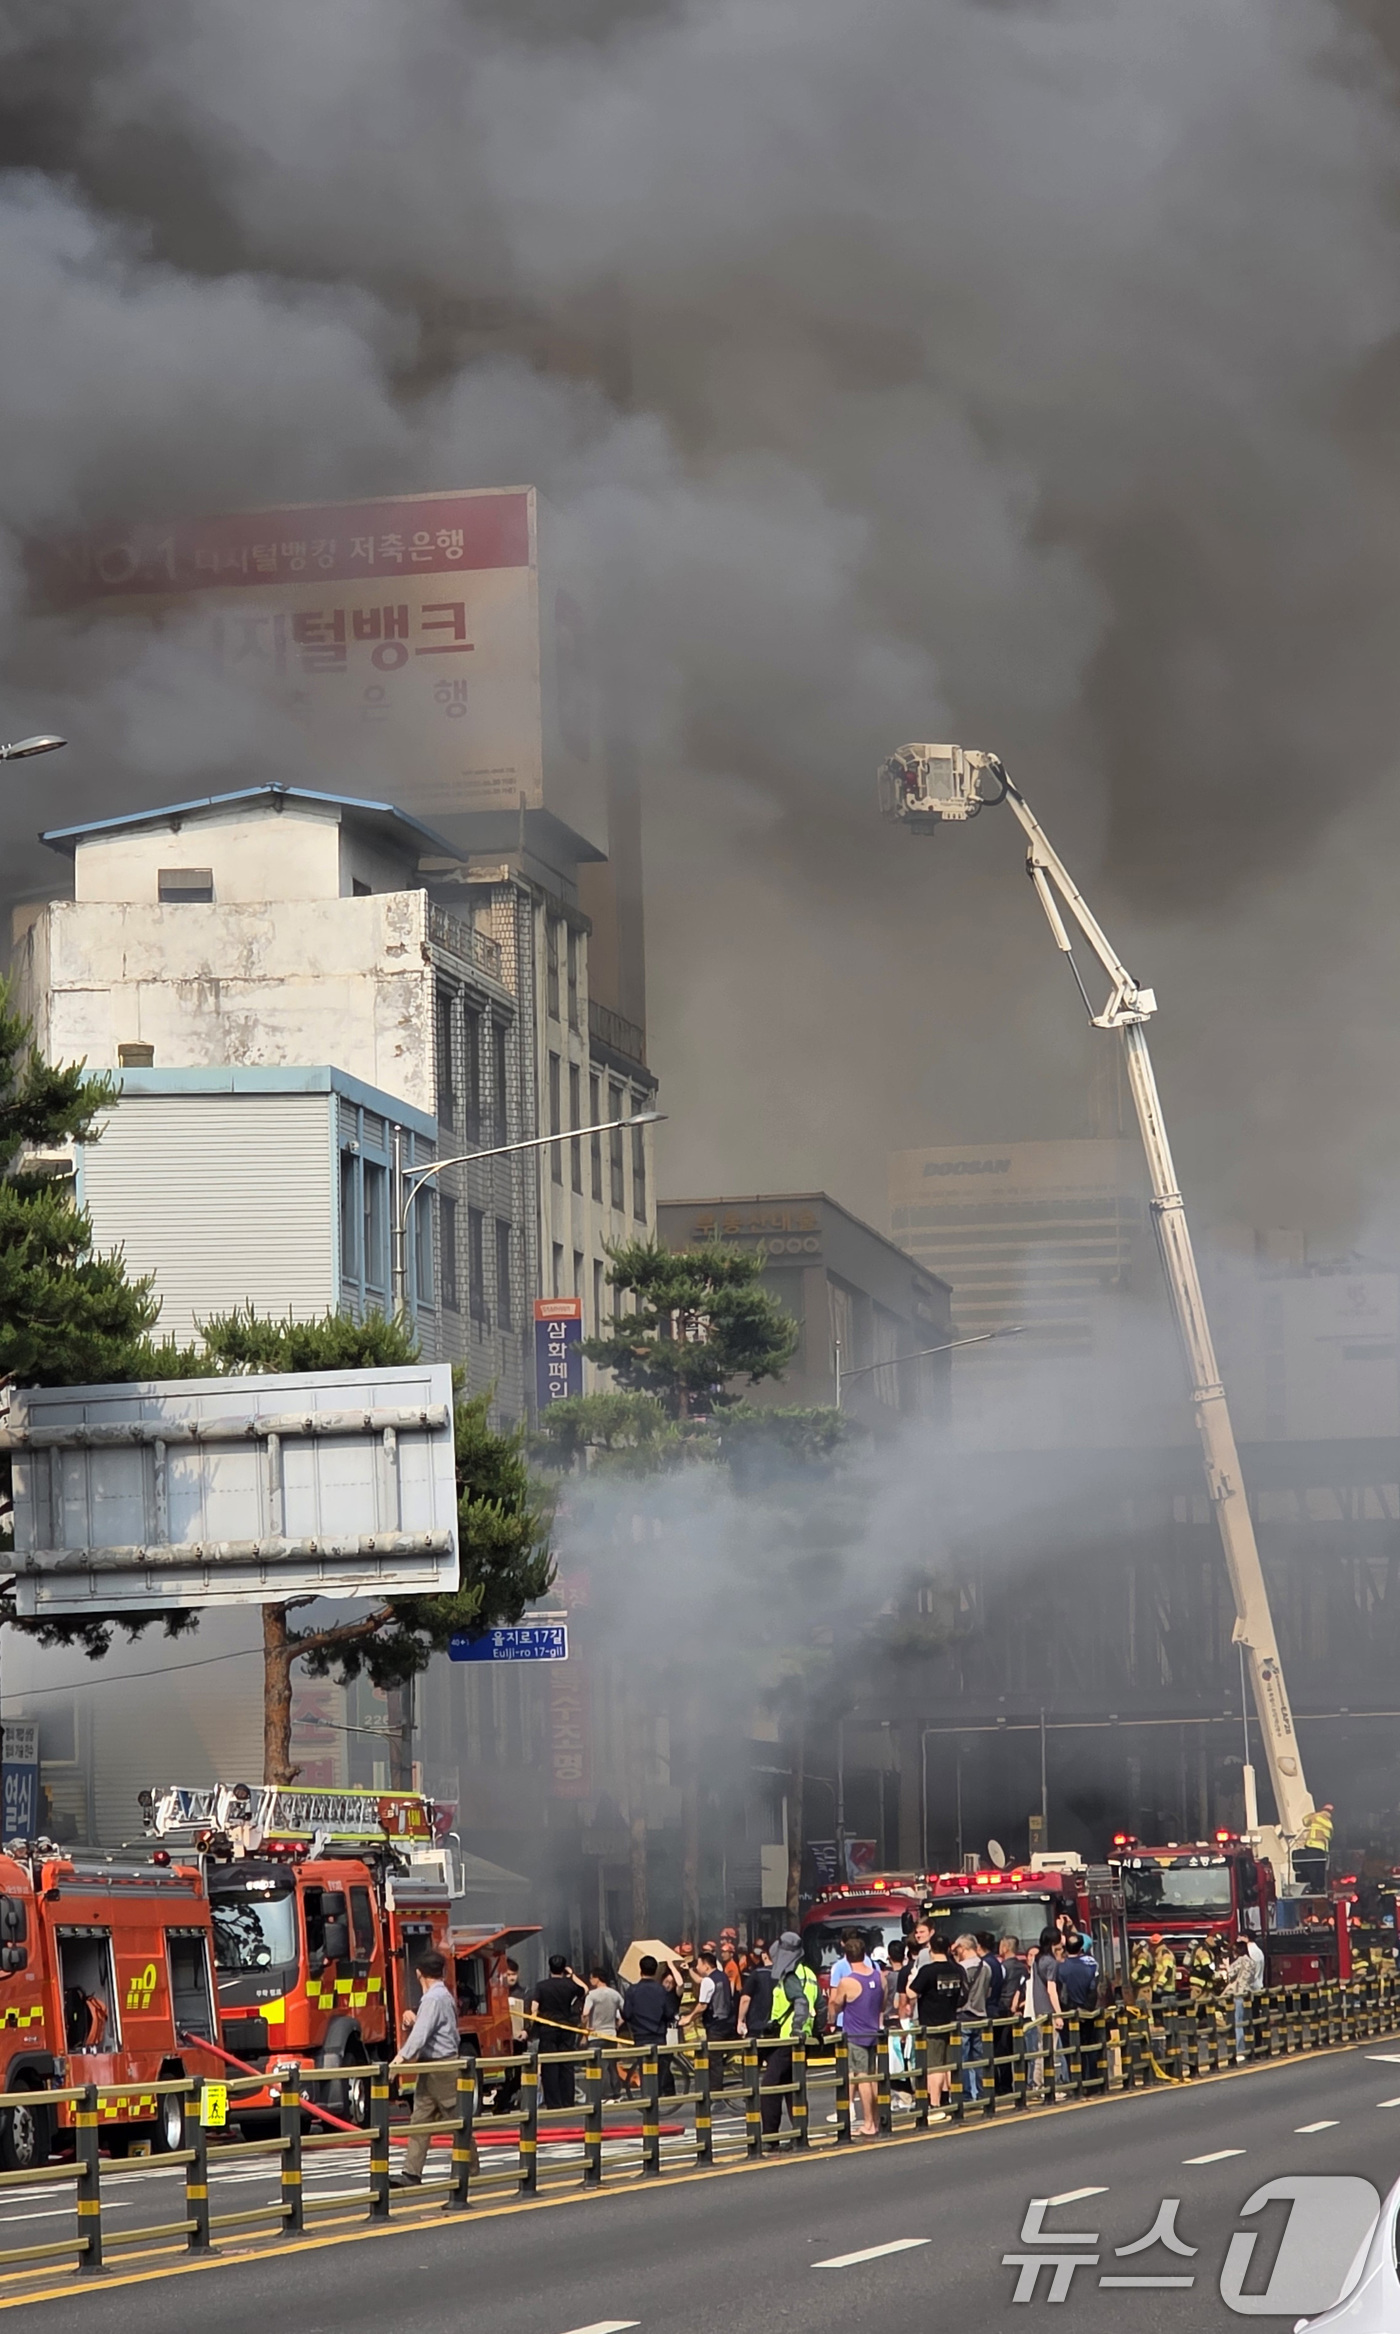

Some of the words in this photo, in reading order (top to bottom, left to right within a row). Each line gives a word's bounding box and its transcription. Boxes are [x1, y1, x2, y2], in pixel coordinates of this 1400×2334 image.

[350, 529, 464, 564] 저축은행
[922, 1158, 1012, 1177] DOOSAN
[547, 1321, 568, 1399] 삼화페인
[491, 1629, 562, 1646] 을지로17길
[493, 1648, 531, 1659] Eulji-ro
[534, 1646, 563, 1659] 17-gil
[5, 1773, 33, 1834] 열쇠
